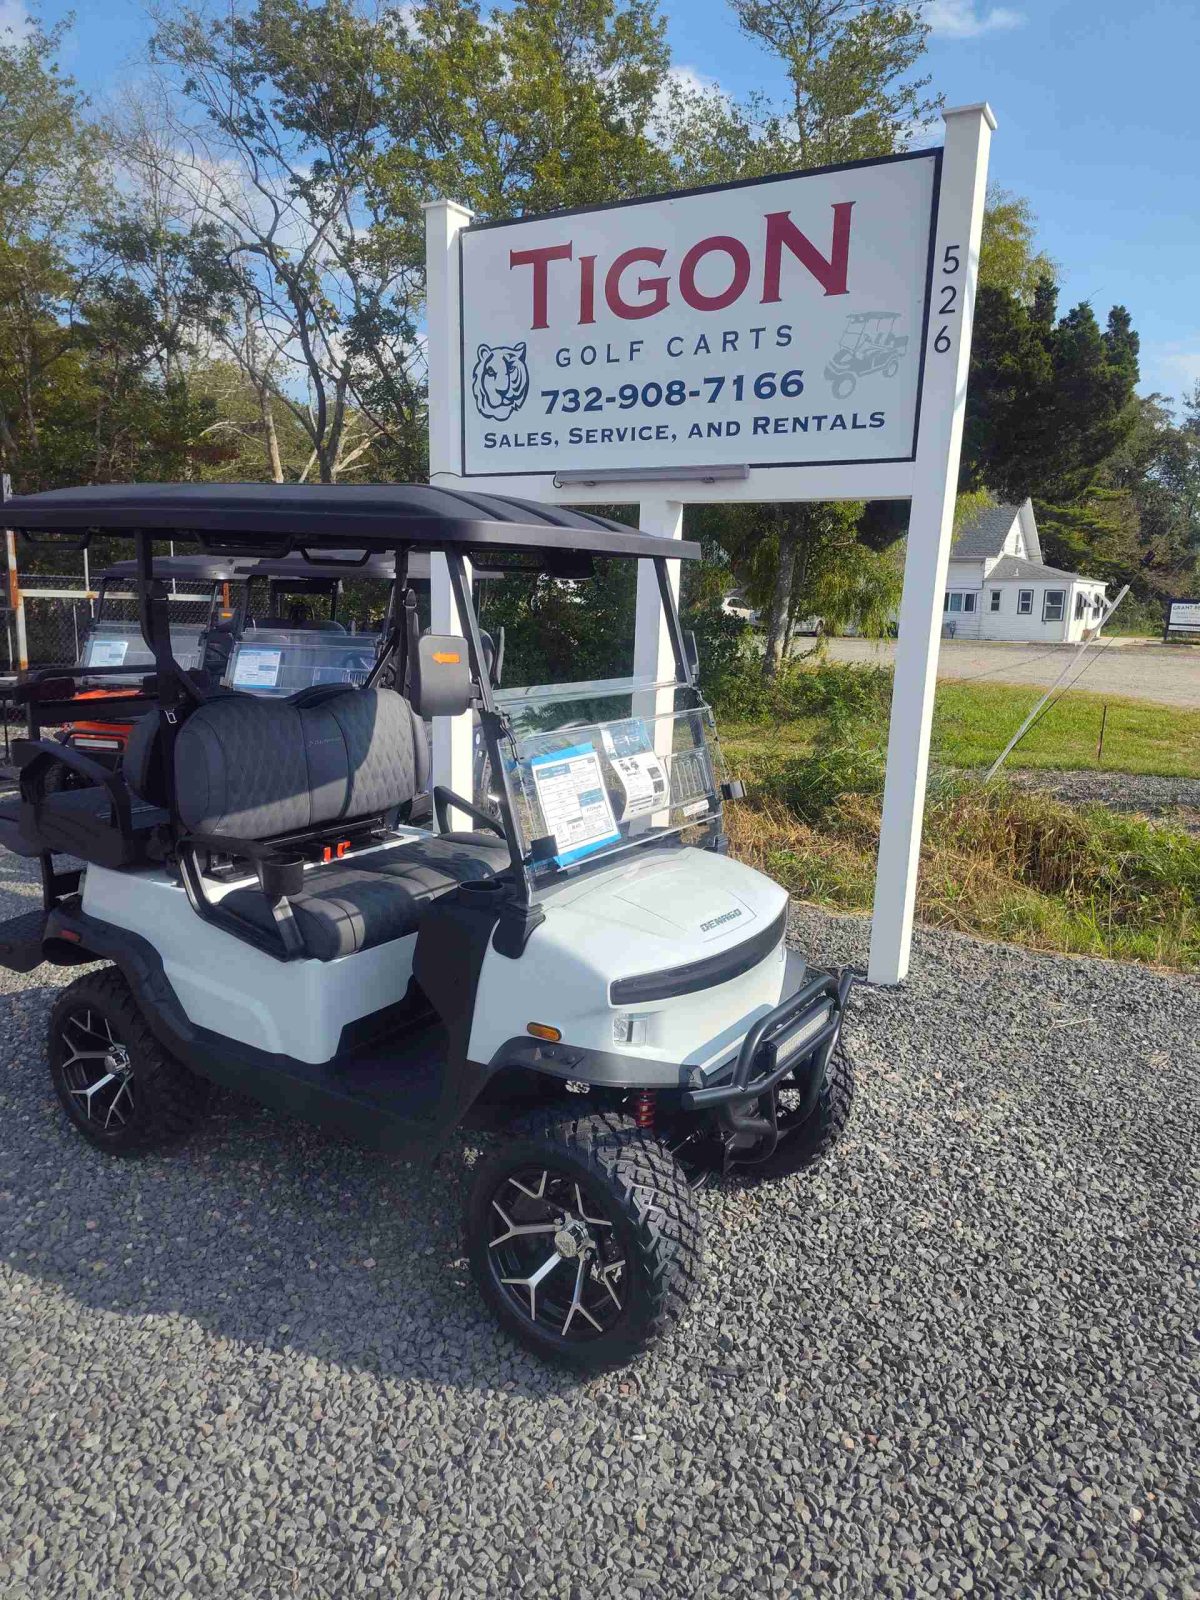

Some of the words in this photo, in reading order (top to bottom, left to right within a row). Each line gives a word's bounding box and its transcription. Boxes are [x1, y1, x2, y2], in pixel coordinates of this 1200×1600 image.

[509, 200, 857, 331] TIGON
[933, 244, 960, 354] 526
[555, 340, 645, 368] GOLF
[666, 324, 793, 358] CARTS
[540, 369, 805, 415] 732-908-7166
[483, 429, 560, 449] SALES,
[568, 423, 677, 445] SERVICE,
[687, 420, 741, 439] AND
[752, 410, 886, 435] RENTALS
